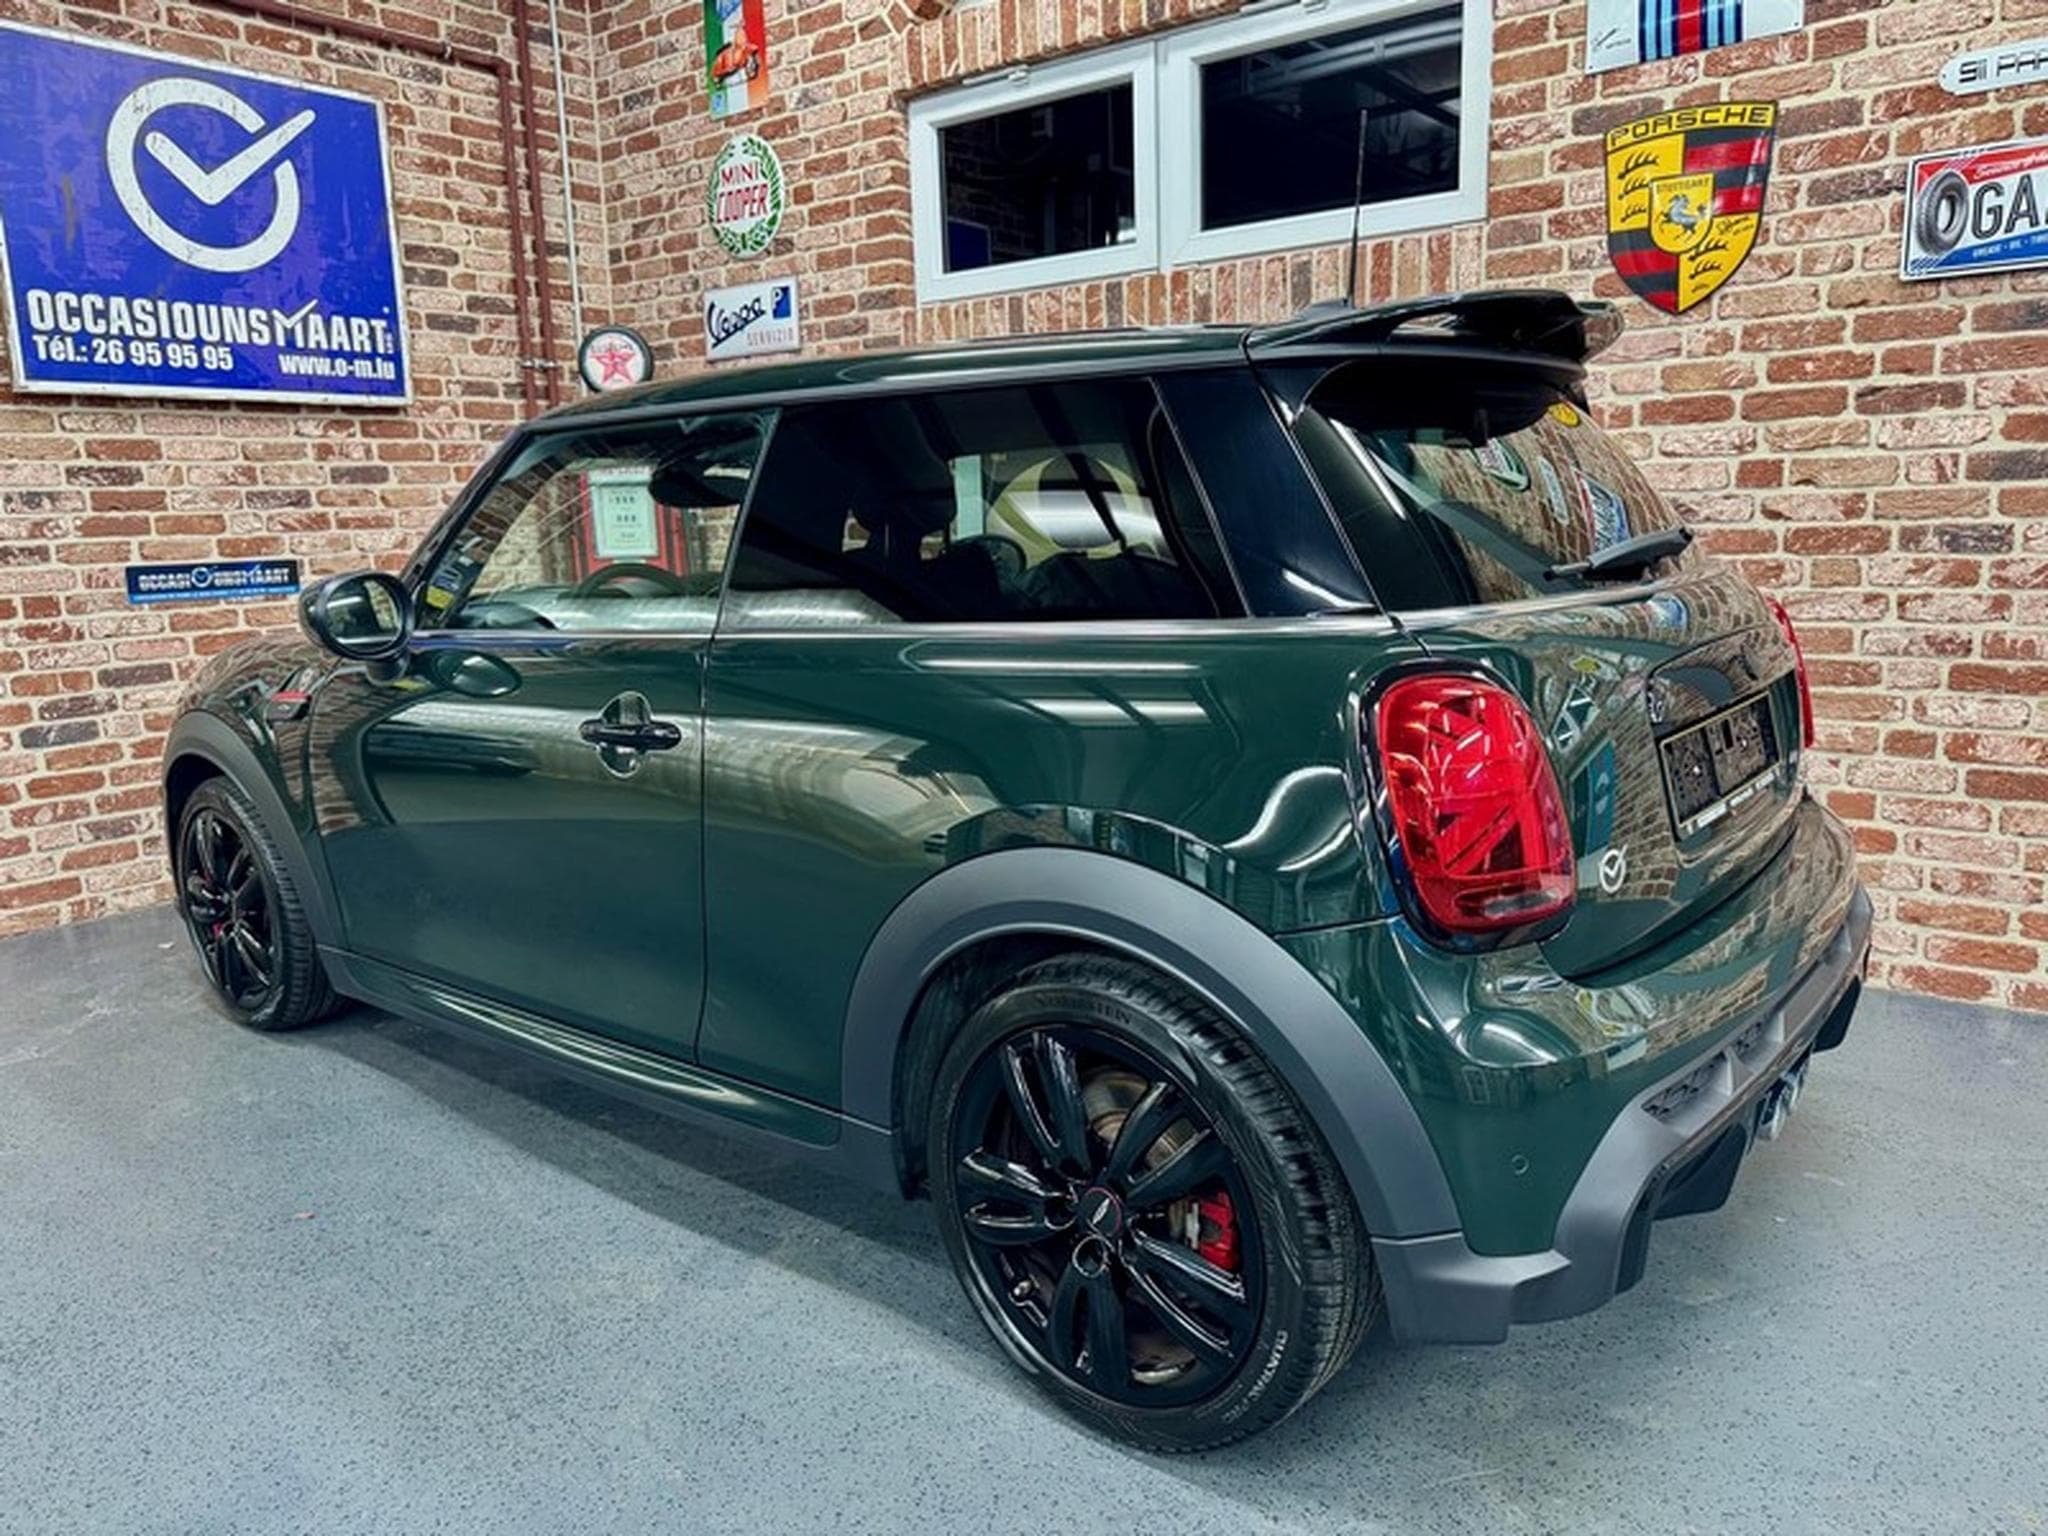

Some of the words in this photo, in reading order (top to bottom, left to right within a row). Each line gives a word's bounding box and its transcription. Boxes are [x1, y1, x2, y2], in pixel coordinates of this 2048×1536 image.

[1609, 106, 1769, 147] PORSCHE
[721, 161, 759, 187] MINI
[716, 183, 768, 224] COOPER
[26, 289, 388, 354] OCCASIOUNSMAART
[708, 295, 766, 349] Vespa
[92, 338, 125, 365] 26
[129, 340, 163, 367] 95
[166, 343, 199, 369] 95
[202, 345, 234, 371] 95
[278, 353, 396, 380] www.o-m.lu
